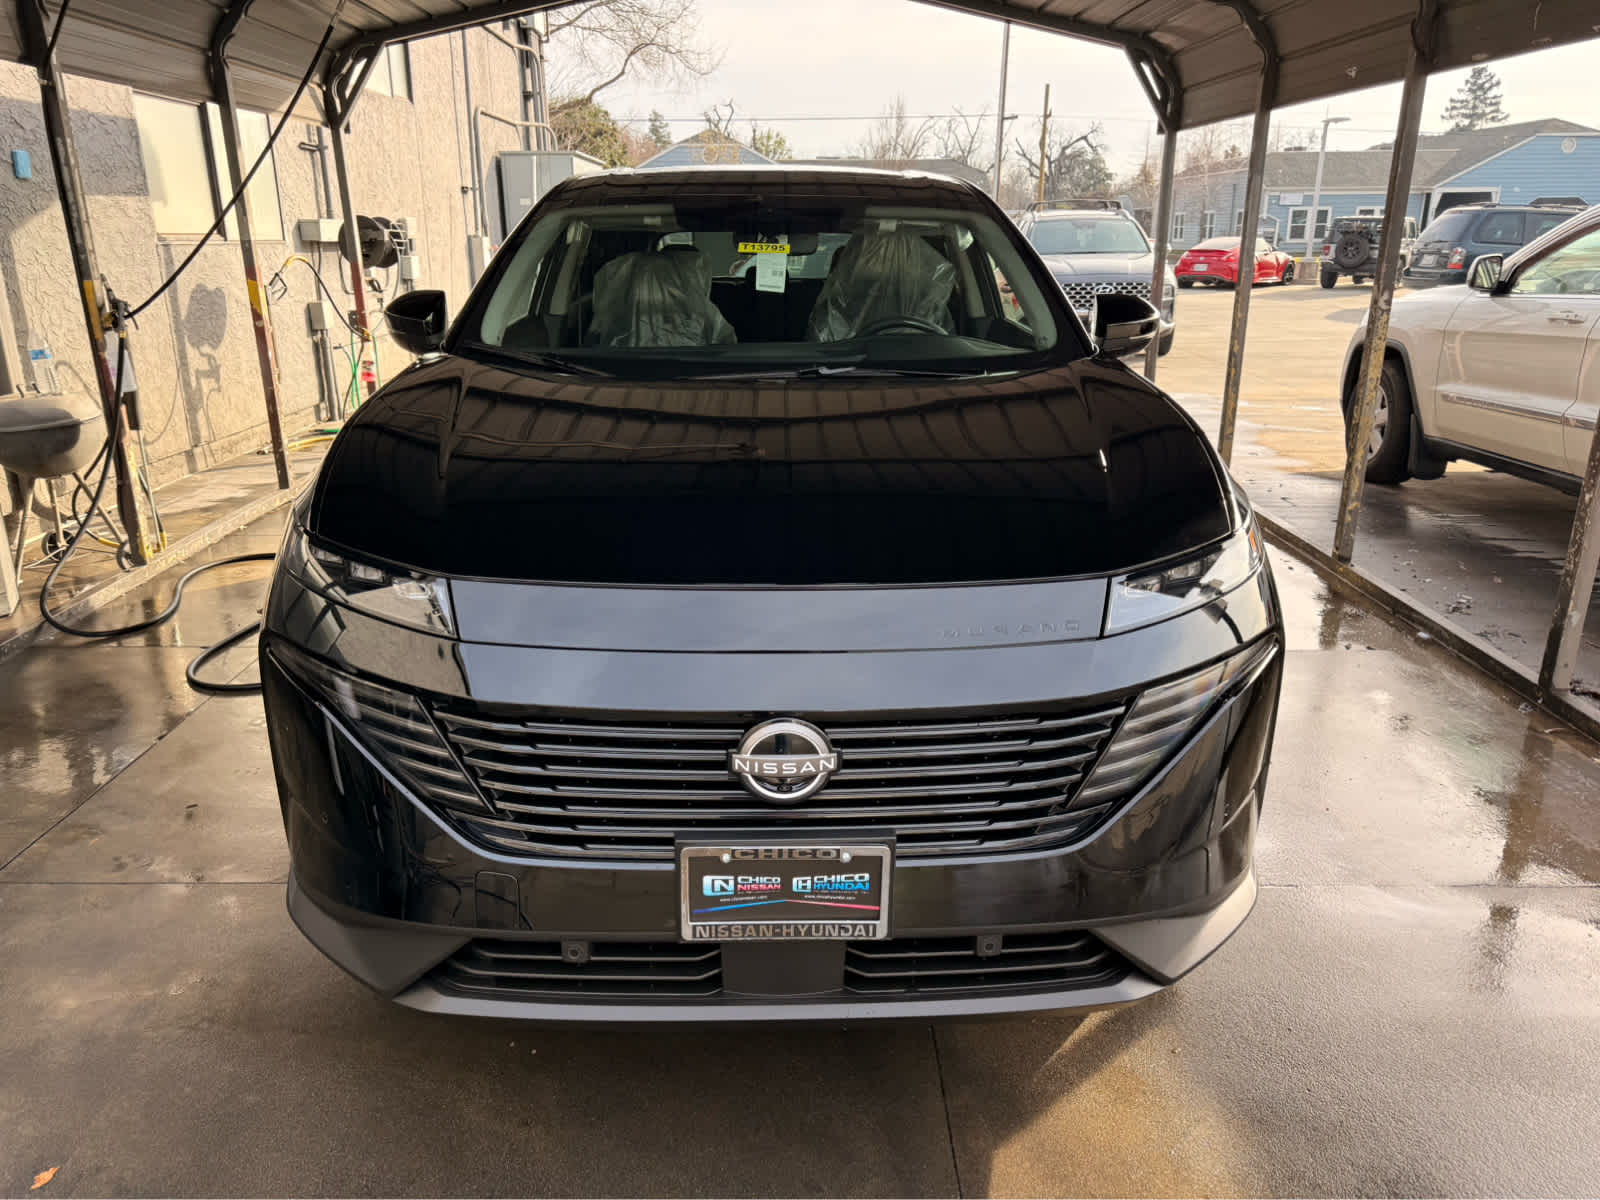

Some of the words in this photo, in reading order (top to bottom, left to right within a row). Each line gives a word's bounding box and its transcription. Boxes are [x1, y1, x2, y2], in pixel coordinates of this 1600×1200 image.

[743, 243, 786, 252] T13795
[734, 757, 835, 775] NISSAN
[734, 849, 837, 859] CHICO
[737, 876, 781, 884] CHICO
[814, 873, 870, 883] CHICO
[814, 882, 870, 890] HYUNDAI
[695, 924, 873, 937] NISSAN-HYUNDAI
